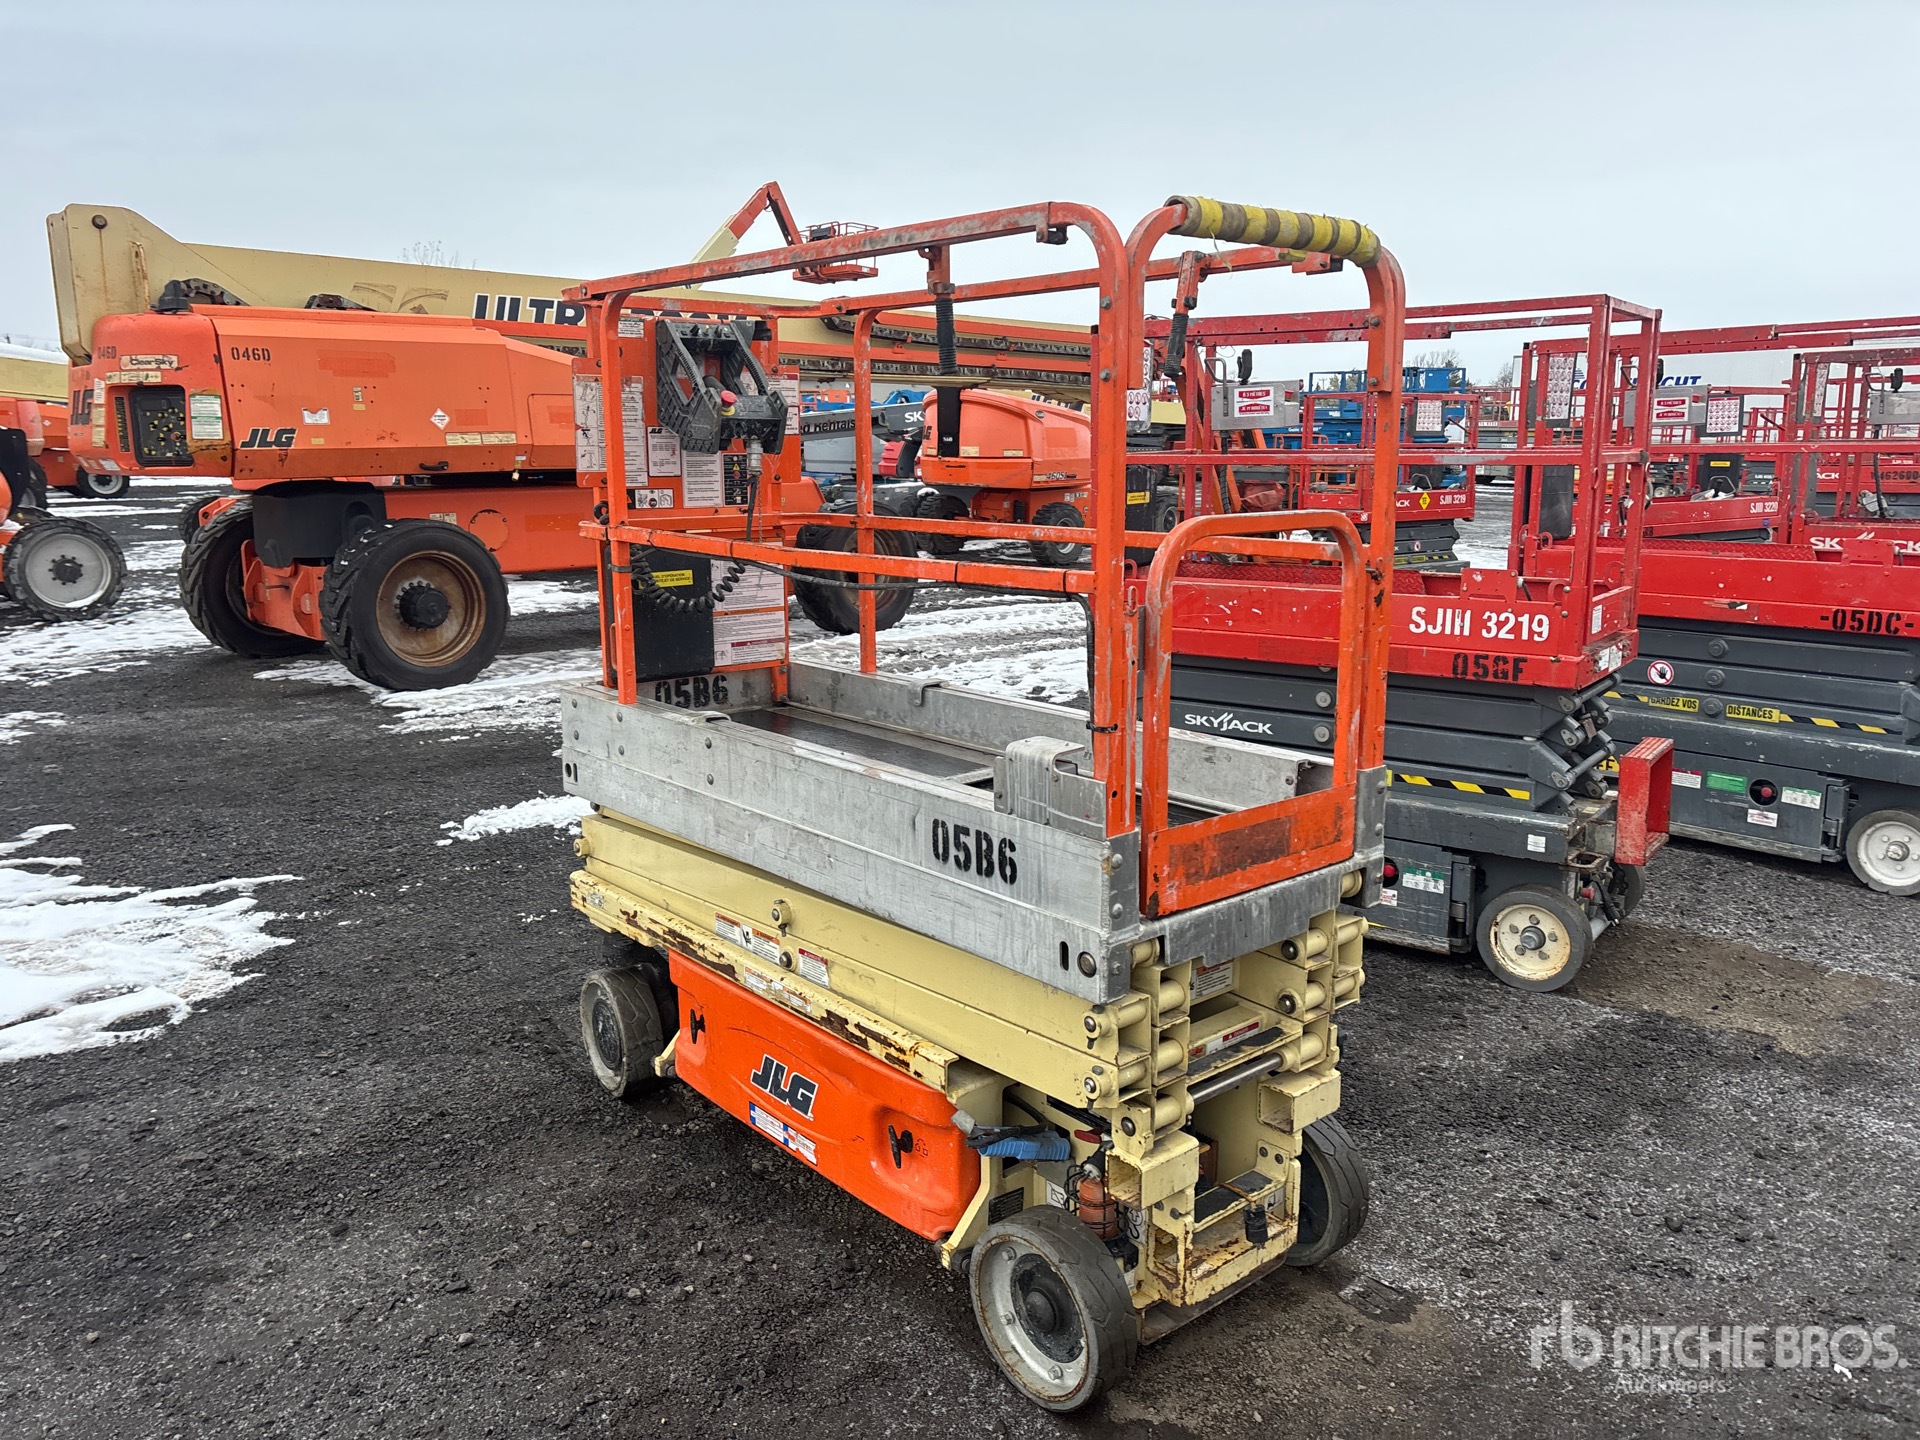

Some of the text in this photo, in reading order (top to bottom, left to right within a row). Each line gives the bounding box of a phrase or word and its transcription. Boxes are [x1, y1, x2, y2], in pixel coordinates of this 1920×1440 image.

[231, 346, 271, 362] 046D
[240, 427, 296, 449] JLG
[649, 427, 664, 435] JLG
[1481, 611, 1550, 642] 3219
[1452, 652, 1528, 682] 05GF
[654, 674, 729, 708] 05B6
[1682, 699, 1698, 710] VOS
[1728, 705, 1774, 720] DISTANCES
[1184, 711, 1274, 736] SKYJACK
[930, 817, 1019, 886] 05B6
[750, 1053, 820, 1121] JLG
